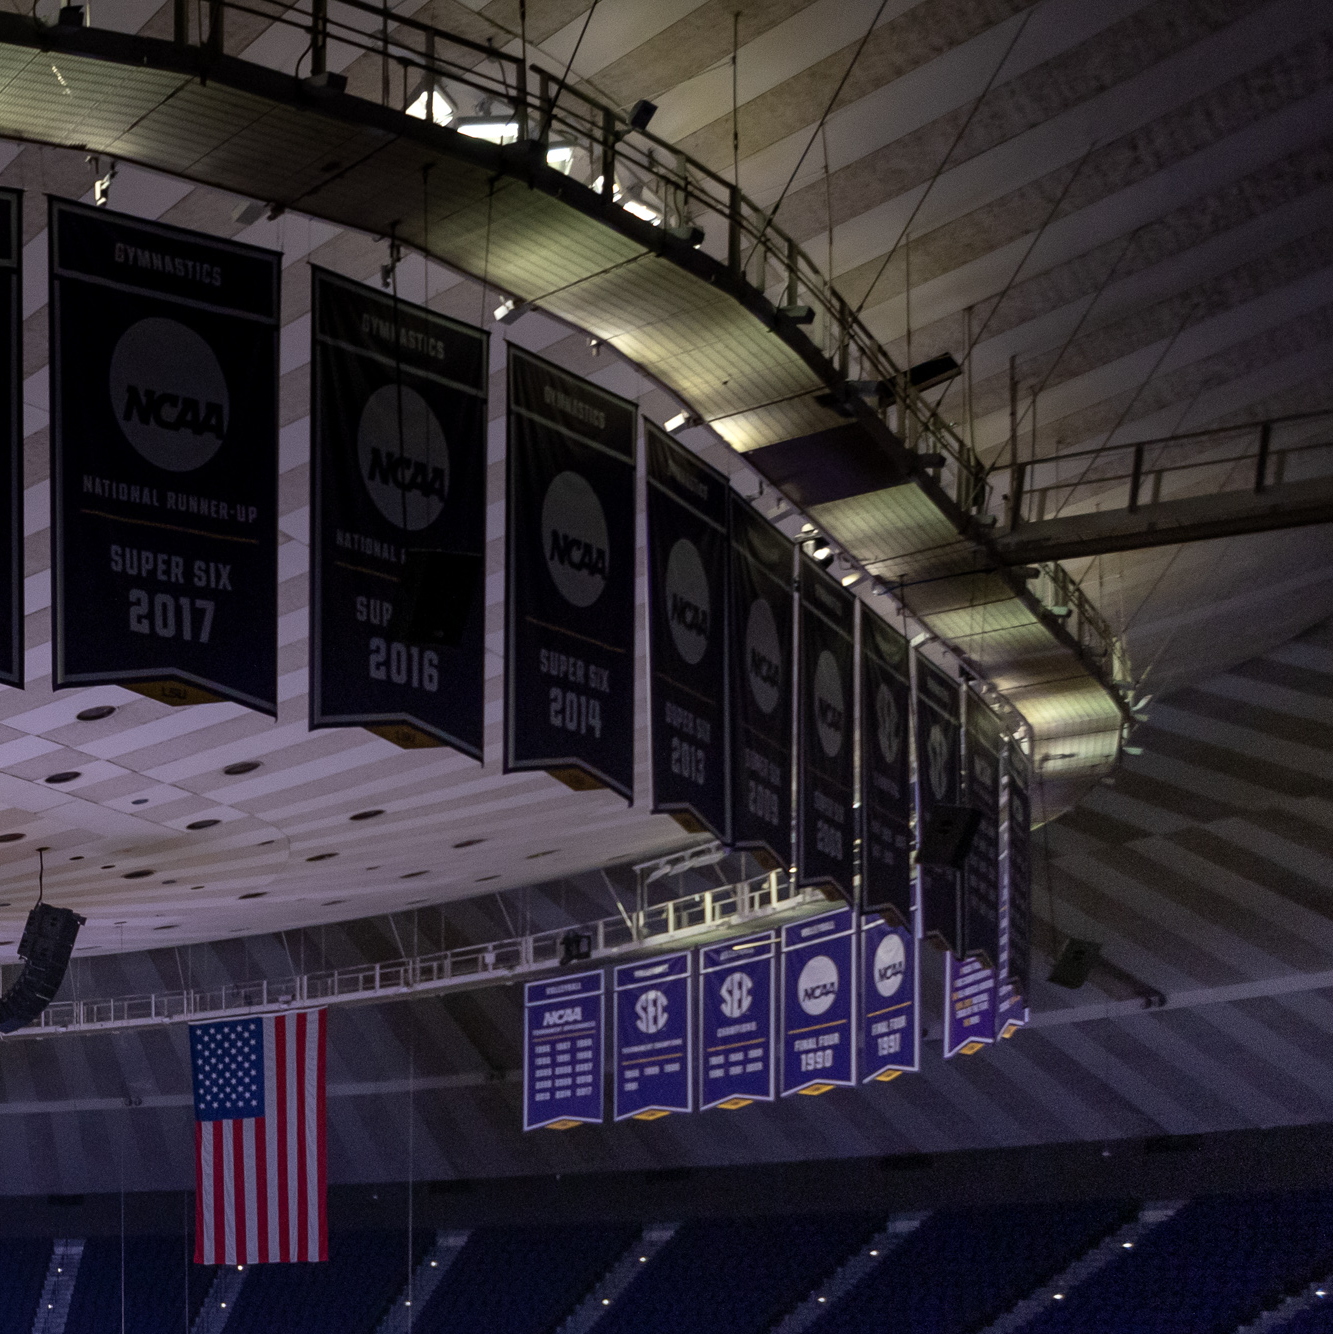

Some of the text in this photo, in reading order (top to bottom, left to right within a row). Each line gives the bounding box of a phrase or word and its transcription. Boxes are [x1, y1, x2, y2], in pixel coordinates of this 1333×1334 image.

[114, 242, 223, 285] GYMNASTICS
[123, 385, 226, 438] NCAA
[370, 448, 447, 500] NCAA
[81, 474, 259, 524] NATIONAL RUNNER-UP
[109, 543, 234, 593] SUPER SIX
[334, 528, 398, 562] NATIONAL
[551, 531, 609, 578] NCAA
[127, 588, 217, 644] 2017
[671, 593, 709, 636] NCAA
[367, 636, 440, 693] 2016
[538, 647, 611, 695] SUPER SIX
[548, 689, 603, 739] 2014
[635, 990, 669, 1034] SEC
[720, 972, 753, 1018] SEC
[803, 983, 836, 1002] NCAA
[543, 1006, 582, 1027] NCAA
[801, 1049, 833, 1072] 1990
